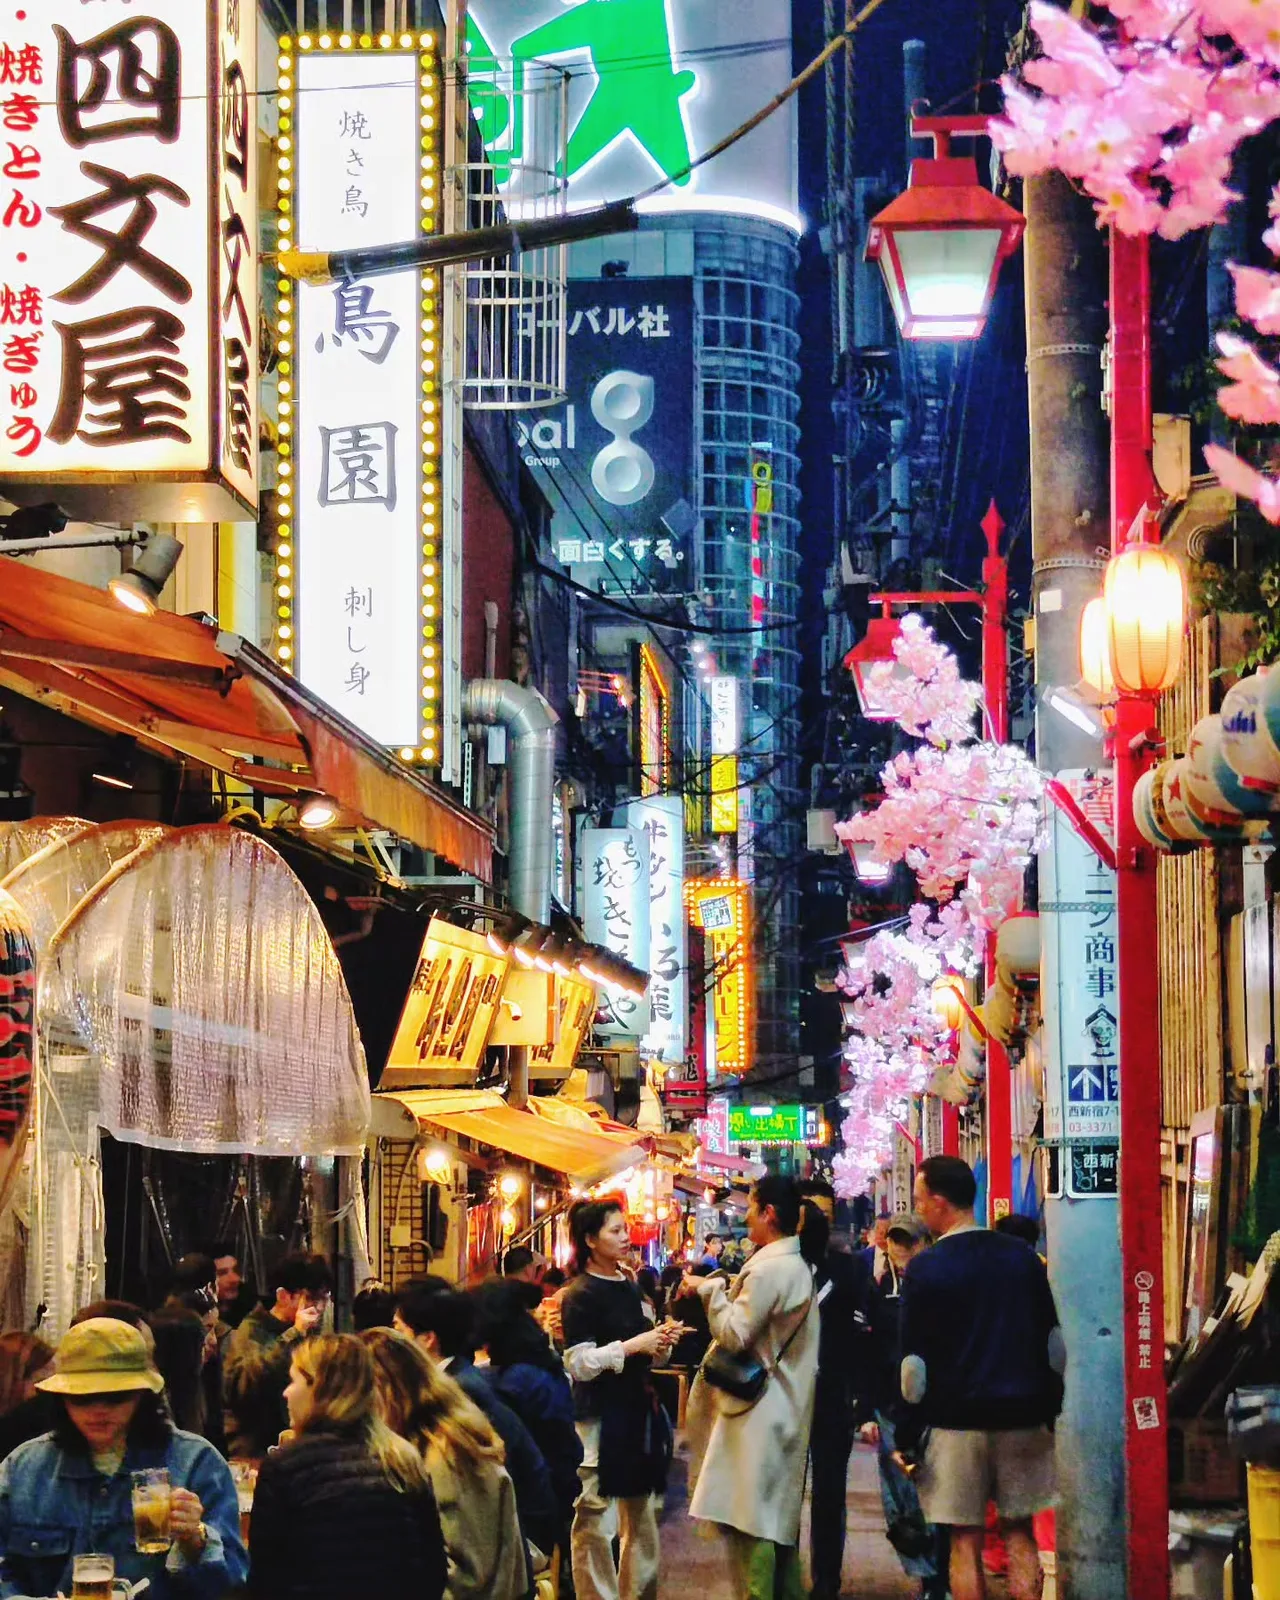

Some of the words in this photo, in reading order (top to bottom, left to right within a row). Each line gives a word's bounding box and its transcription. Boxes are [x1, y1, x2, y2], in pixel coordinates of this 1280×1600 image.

[338, 110, 372, 218] 焼き鳥
[45, 14, 193, 446] 四文屋
[314, 277, 400, 513] 鳥園
[524, 456, 561, 468] Group
[343, 586, 373, 696] 刺し身
